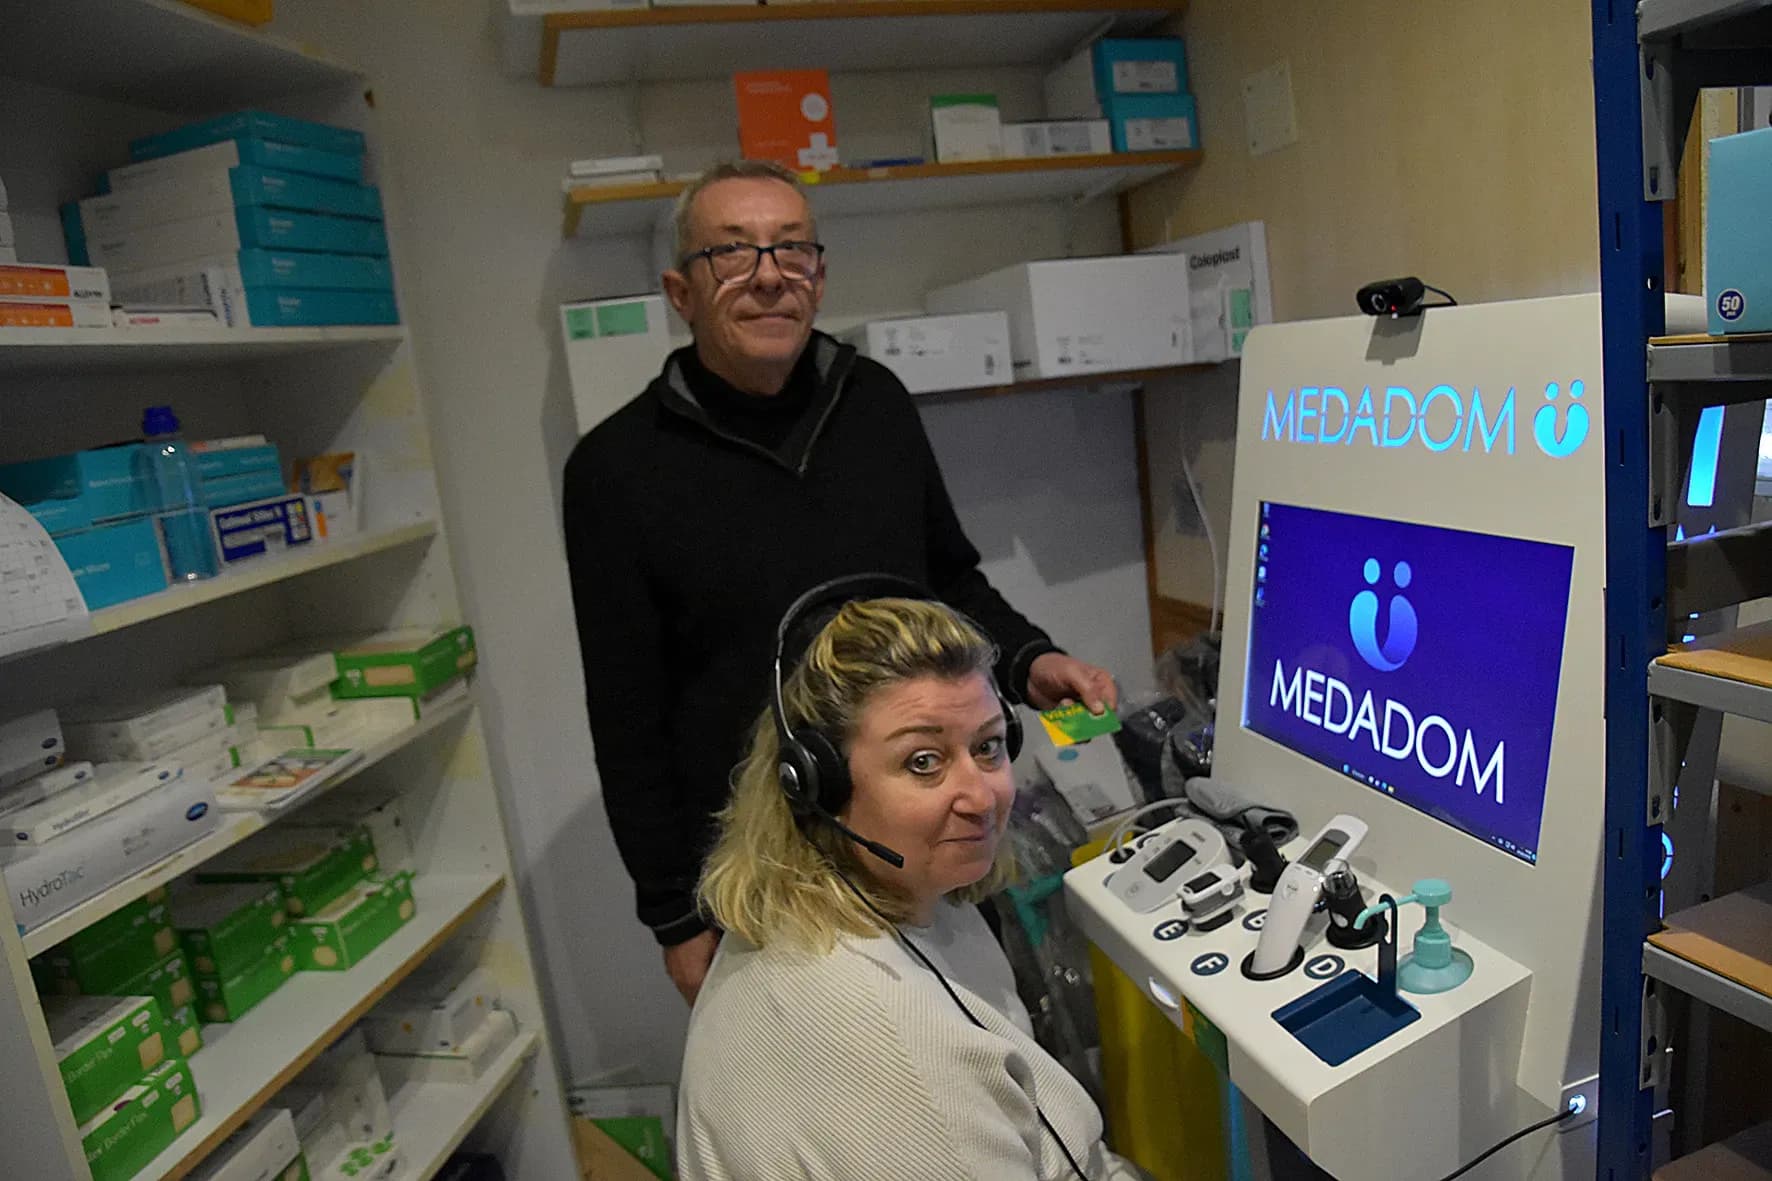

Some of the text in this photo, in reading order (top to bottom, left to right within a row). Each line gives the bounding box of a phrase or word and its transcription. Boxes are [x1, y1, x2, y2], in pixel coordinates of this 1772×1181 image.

[1189, 246, 1241, 270] Coloplast
[1721, 295, 1741, 311] 50
[1261, 385, 1516, 455] MEDADOM
[1269, 658, 1505, 804] MEDADOM
[1158, 922, 1183, 938] E
[1196, 955, 1224, 971] F
[1309, 957, 1338, 976] D
